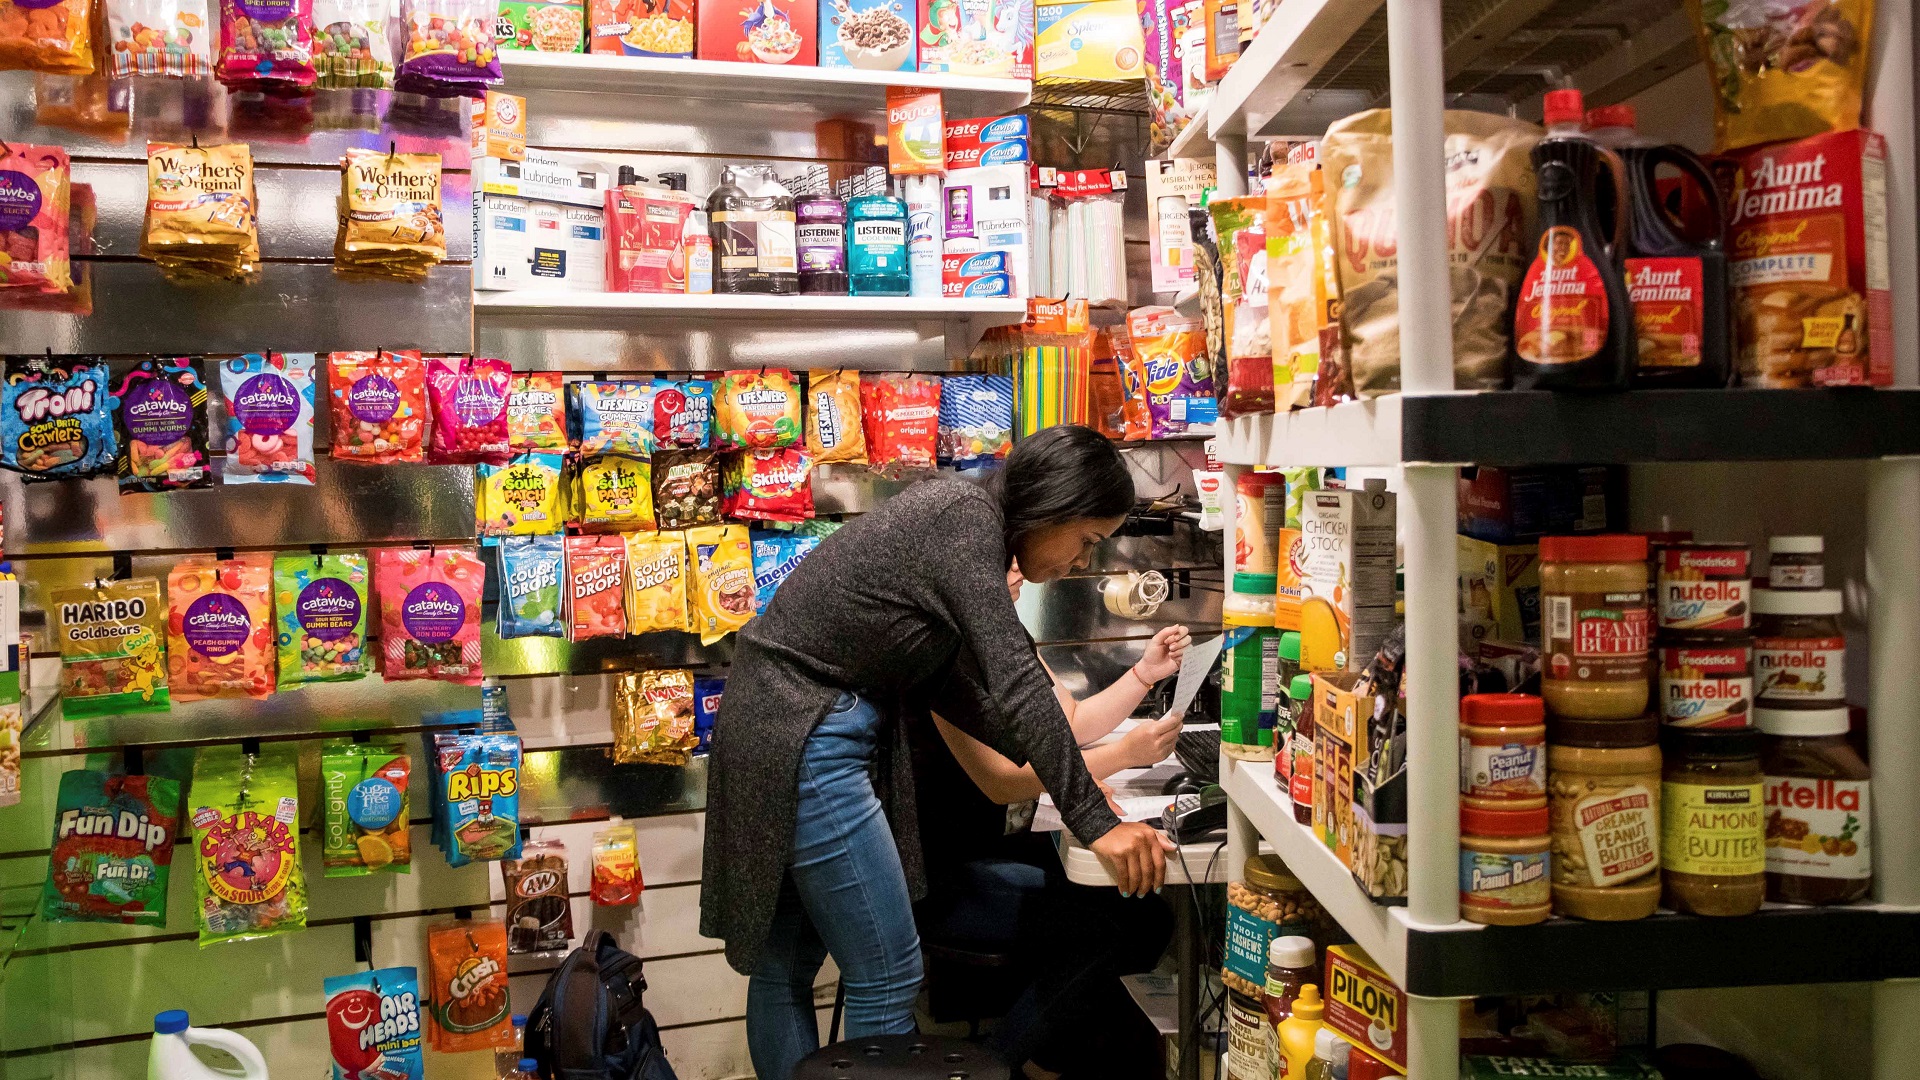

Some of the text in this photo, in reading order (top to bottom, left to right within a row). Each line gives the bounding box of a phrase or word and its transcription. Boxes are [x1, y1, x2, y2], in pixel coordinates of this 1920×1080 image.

[1038, 6, 1063, 16] 1200
[890, 105, 937, 124] bounce
[490, 129, 524, 140] Baking Soda
[946, 124, 980, 139] gate
[990, 123, 1012, 132] Cavity
[946, 148, 980, 163] gate
[990, 148, 1013, 157] Cavity
[155, 156, 245, 178] Werther's
[356, 164, 437, 187] Werther's
[1752, 153, 1827, 190] Aunt
[180, 174, 241, 194] Original
[524, 168, 572, 186] Lubriderm
[1161, 175, 1192, 184] VISIBLY
[0, 187, 37, 202] awba
[376, 184, 435, 205] Original
[488, 199, 527, 214] Lubriderm
[1731, 182, 1844, 226] Jemima
[535, 209, 560, 218] Lubriderm
[566, 209, 601, 223] Lubriderm
[472, 190, 481, 259] Lubriderm
[799, 228, 840, 237] LISTERINE
[858, 224, 901, 235] LISTERINE
[981, 220, 1022, 231] Lubriderm
[970, 258, 994, 267] Cavity
[1540, 266, 1578, 281] Aunt
[1634, 266, 1683, 286] Aunt
[973, 282, 997, 291] Cavity
[1525, 278, 1587, 302] Jemima
[1144, 358, 1179, 387] Tide
[18, 380, 97, 421] Trolli
[239, 393, 294, 408] catawba
[353, 389, 397, 401] catawba
[685, 396, 709, 411] AIR
[130, 400, 187, 416] catawba
[895, 410, 930, 418] SMARTIES
[30, 419, 81, 434] SOUR BRITE
[599, 413, 641, 423] GUMMIES
[670, 409, 708, 428] HEADS
[19, 426, 83, 452] Crawlers
[900, 426, 927, 435] original
[505, 477, 544, 490] SOUR
[598, 477, 636, 490] SOUR
[672, 486, 690, 496] minis
[504, 489, 546, 502] PATCH
[597, 488, 638, 501] PATCH
[1305, 521, 1348, 536] CHICKEN
[1310, 537, 1343, 551] STOCK
[634, 554, 679, 579] COUGH
[755, 548, 812, 588] mentos
[1679, 555, 1737, 568] Breadsticks
[510, 561, 557, 585] COUGH
[574, 561, 621, 585] COUGH
[635, 566, 680, 591] DROPS
[511, 573, 557, 598] DROPS
[575, 573, 621, 599] DROPS
[1670, 580, 1741, 602] nutella
[63, 599, 145, 624] HARIBO
[302, 596, 355, 610] catawba
[408, 603, 460, 615] catawba
[189, 613, 249, 627] catawba
[330, 620, 353, 628] BEARS
[70, 625, 141, 640] Goldbears
[432, 630, 451, 638] BONS
[126, 633, 152, 650] Sour
[1581, 637, 1646, 652] BUTTE
[1678, 653, 1736, 666] Breadsticks
[1759, 652, 1827, 669] nutella
[644, 686, 687, 705] TWIX
[1670, 679, 1742, 700] nutella
[640, 718, 660, 730] minis
[1488, 753, 1532, 770] Peanut
[1492, 764, 1531, 782] Butter
[355, 784, 393, 799] Sugar
[450, 769, 517, 800] Rips
[328, 770, 347, 849] GoLightly
[362, 794, 389, 808] free
[1596, 812, 1643, 832] CREAMY
[1688, 811, 1757, 830] ALMOND
[59, 809, 166, 852] Fun Dip
[201, 811, 296, 857] CRY BABY
[1594, 822, 1646, 849] PEANUT
[1598, 838, 1650, 865] BUTTER
[1688, 837, 1758, 859] BUTTER
[595, 853, 620, 863] Vitamin
[97, 863, 149, 880] Fun Di
[1472, 868, 1510, 892] Peanut
[209, 876, 230, 898] EXTRA
[229, 889, 265, 903] SOUR
[525, 872, 556, 896] A&W
[1232, 922, 1263, 942] WHOLE
[1232, 932, 1263, 955] CASHEWS
[1235, 945, 1262, 965] SEA SALT
[448, 956, 500, 999] Crush
[380, 992, 416, 1021] AIR
[1332, 968, 1396, 1028] PILON
[1231, 1005, 1259, 1024] KIRKLAND
[359, 1013, 420, 1051] HEADS
[376, 1039, 401, 1053] mini
